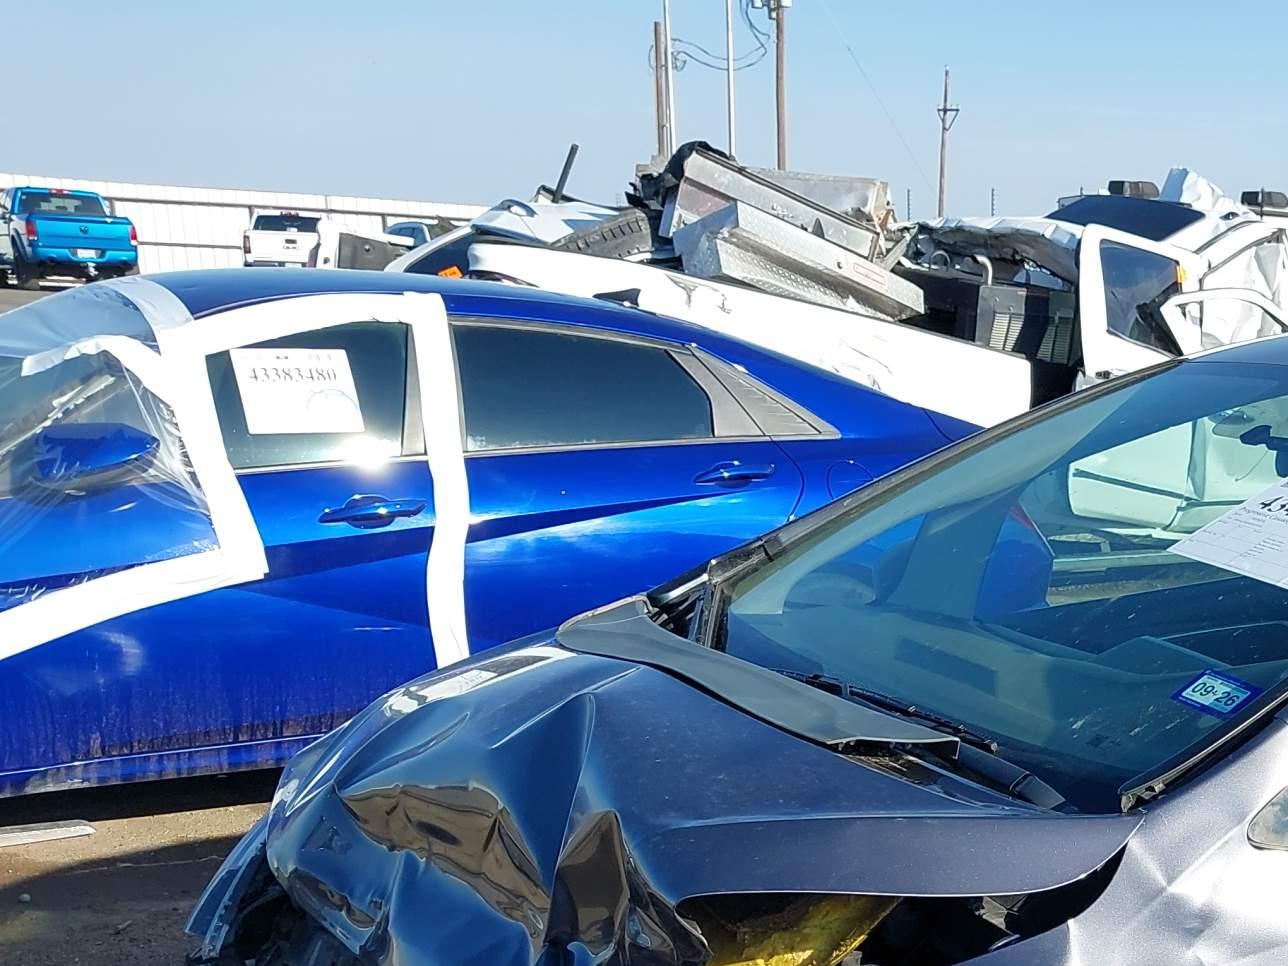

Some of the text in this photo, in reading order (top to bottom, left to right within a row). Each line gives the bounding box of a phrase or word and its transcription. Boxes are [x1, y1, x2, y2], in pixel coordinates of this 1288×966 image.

[248, 367, 337, 382] 43383480
[1191, 682, 1215, 697] 09
[1214, 691, 1240, 706] 26
